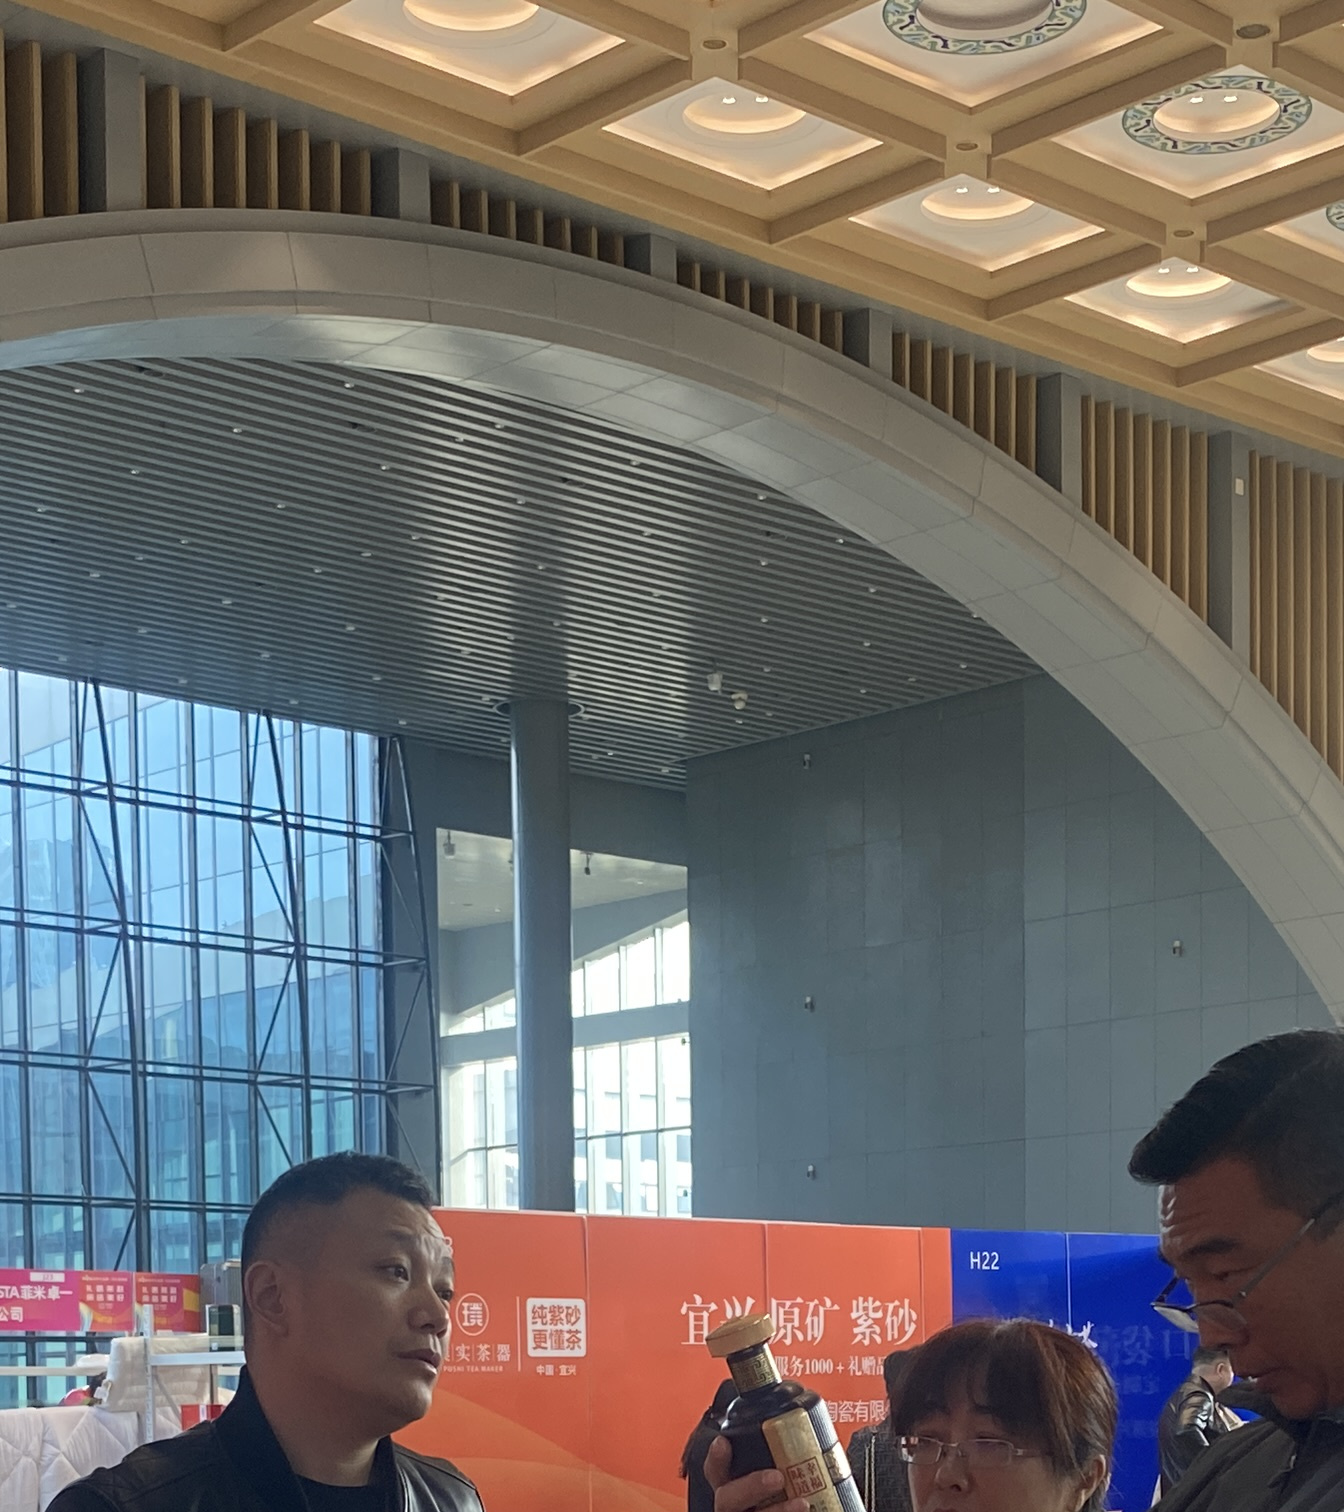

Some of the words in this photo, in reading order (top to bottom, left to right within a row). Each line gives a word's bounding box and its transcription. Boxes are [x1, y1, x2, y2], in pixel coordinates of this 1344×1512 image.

[969, 1251, 1000, 1270] H22
[531, 1304, 581, 1326] 纯紫砂
[768, 1296, 840, 1346] 原矿
[849, 1296, 918, 1346] 紫砂
[532, 1329, 582, 1351] 更懂茶
